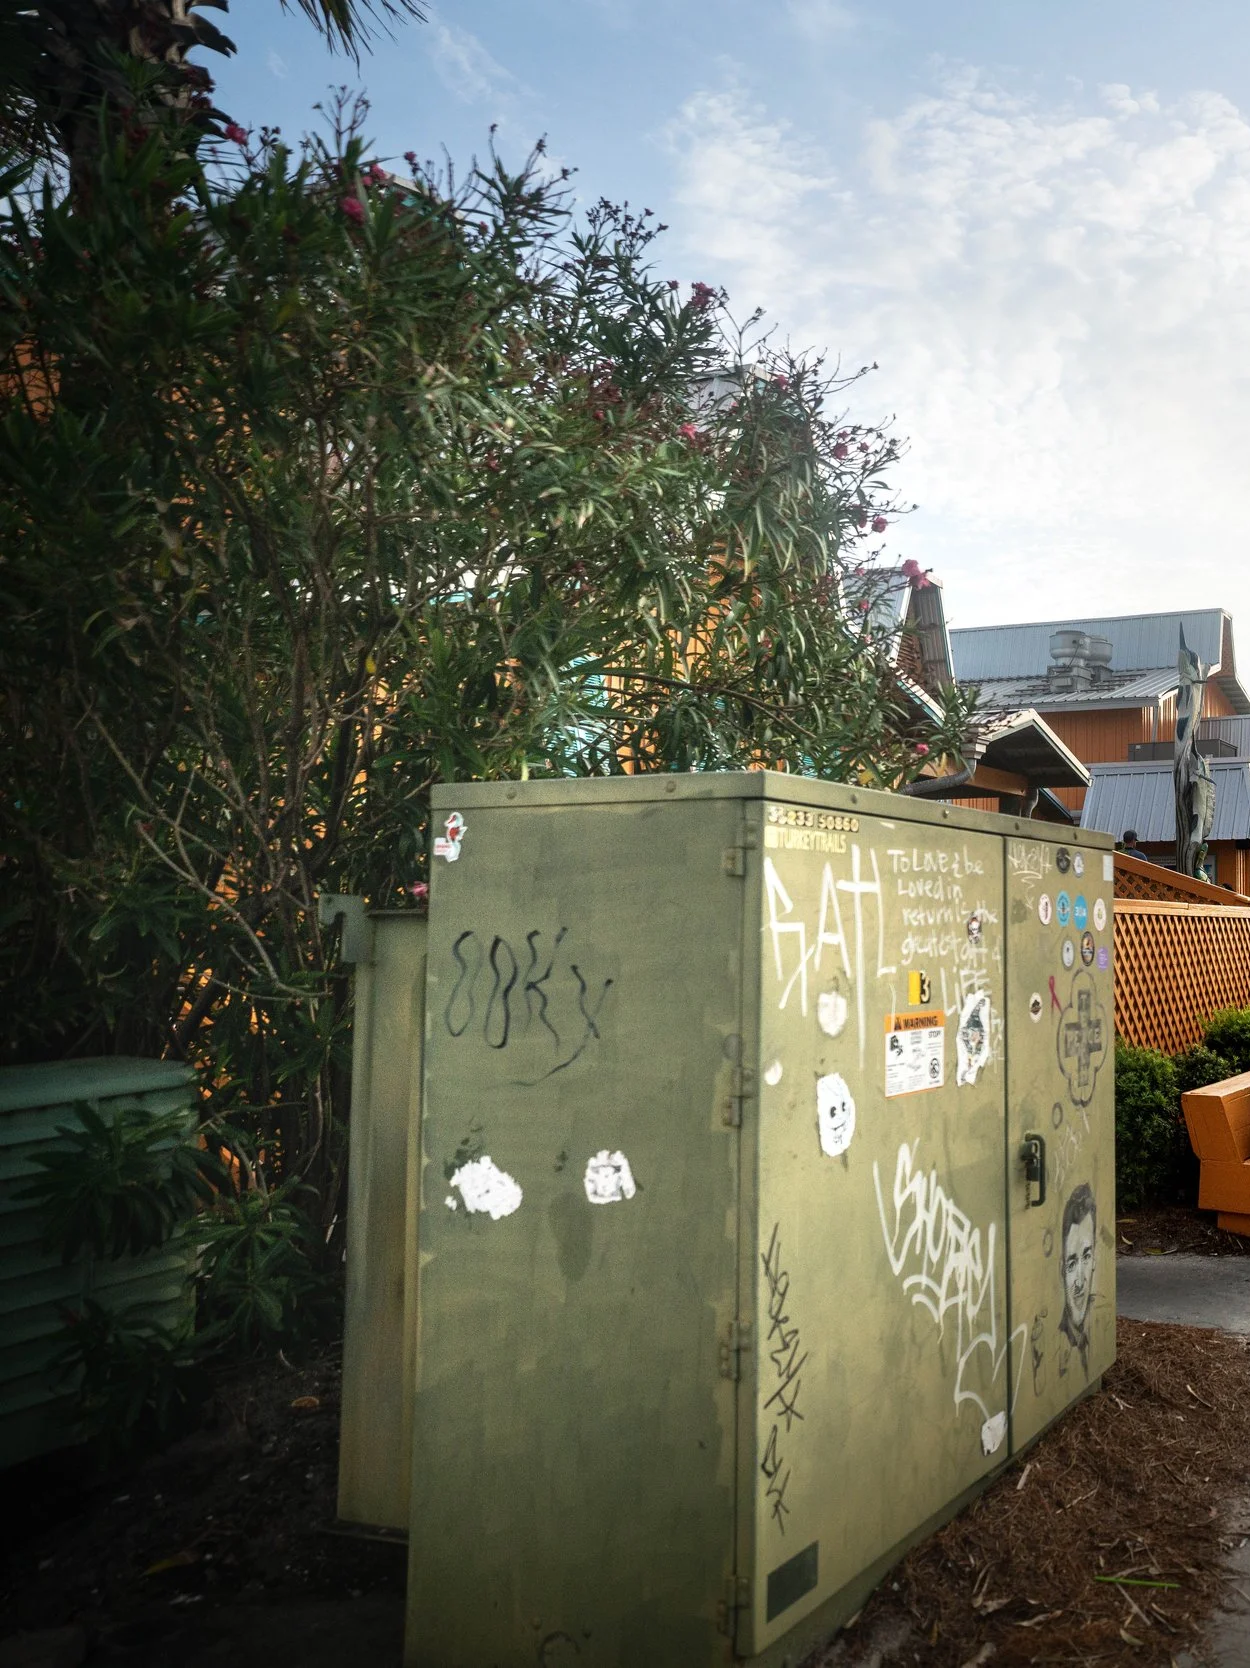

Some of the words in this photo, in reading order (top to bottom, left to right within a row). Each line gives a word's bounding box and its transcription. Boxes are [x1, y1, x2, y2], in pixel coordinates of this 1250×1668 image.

[887, 849, 910, 873] To
[912, 848, 949, 873] Love
[963, 844, 985, 875] be
[897, 876, 944, 902] Loved
[947, 878, 963, 900] in
[903, 1015, 938, 1031] WARNING
